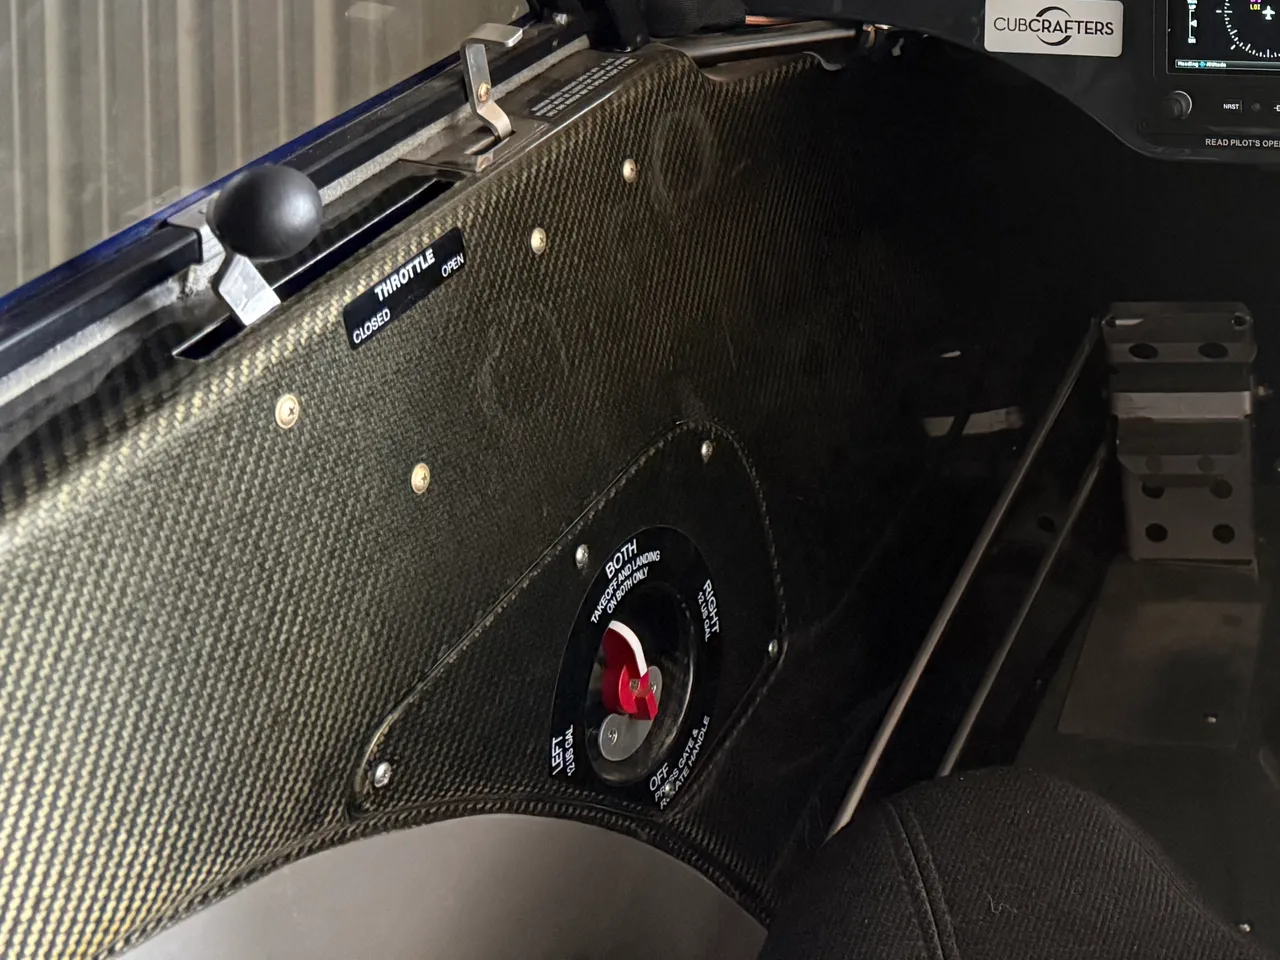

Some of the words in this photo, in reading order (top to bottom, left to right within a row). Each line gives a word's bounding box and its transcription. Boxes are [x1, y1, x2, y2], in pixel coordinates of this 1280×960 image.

[993, 17, 1114, 36] CUBCRAFTERS
[1205, 138, 1229, 146] READ
[1230, 138, 1261, 147] PILOT'S
[374, 248, 436, 302] THROTTLE
[441, 252, 465, 278] OPEN
[353, 308, 391, 344] CLOSED
[605, 538, 637, 580] BOTH
[590, 577, 618, 624] TAKEOFF
[618, 563, 632, 585] AND
[632, 550, 661, 571] LANDING
[606, 596, 617, 614] ON
[615, 577, 633, 602] BOTH
[632, 566, 649, 584] ONLY
[697, 591, 705, 605] 12
[703, 579, 720, 633] RIGHT
[565, 724, 574, 748] GAL
[678, 737, 695, 769] GATE
[692, 728, 700, 738] &
[688, 715, 710, 768] HANDLE
[552, 736, 564, 776] LEFT
[565, 747, 574, 765] US
[566, 761, 576, 777] 12
[649, 762, 669, 791] OFF
